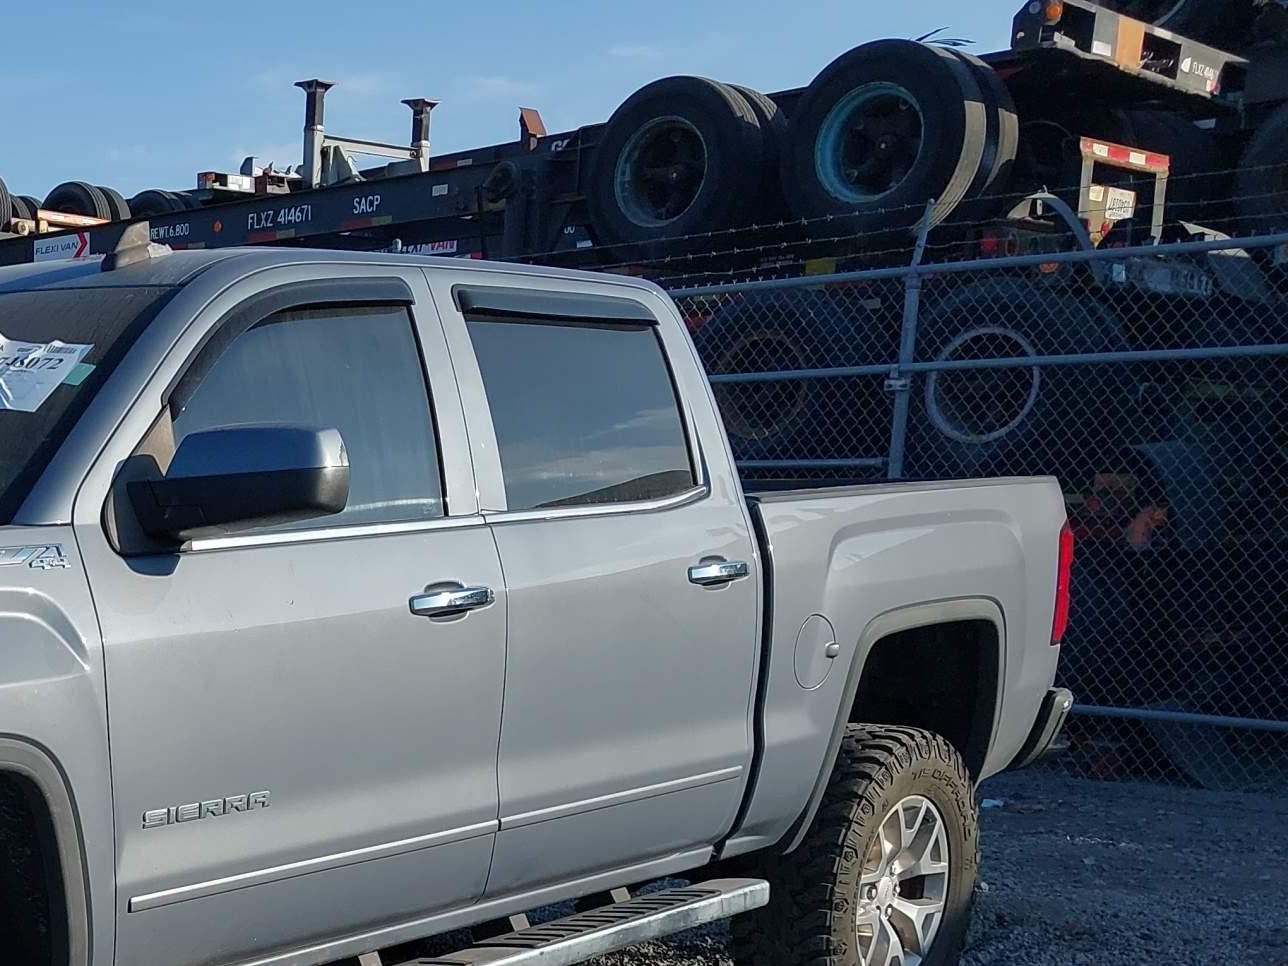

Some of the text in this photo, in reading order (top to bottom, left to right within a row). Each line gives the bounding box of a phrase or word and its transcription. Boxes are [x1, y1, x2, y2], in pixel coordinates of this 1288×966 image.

[353, 194, 381, 214] SACP
[247, 204, 312, 230] FLXZ 414671
[35, 240, 79, 255] FLEXI VAN
[142, 790, 272, 830] SIERRA
